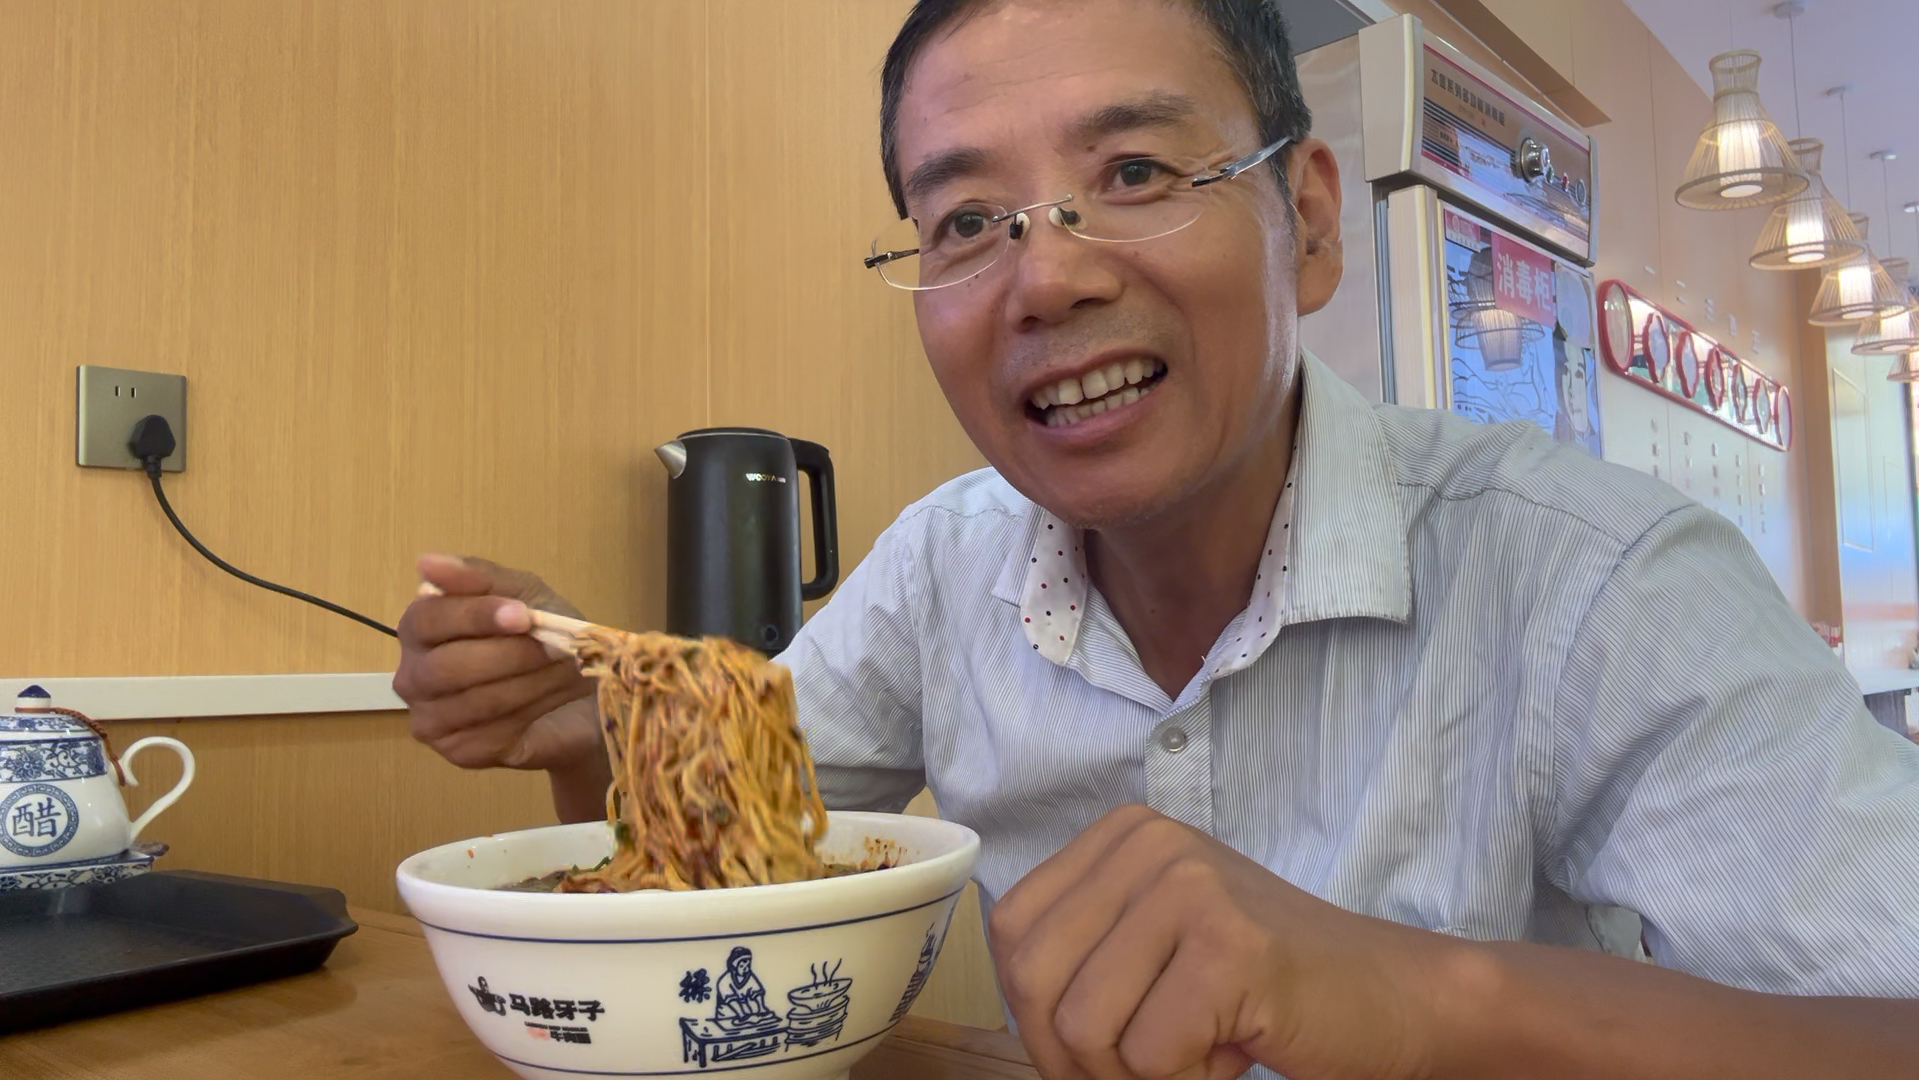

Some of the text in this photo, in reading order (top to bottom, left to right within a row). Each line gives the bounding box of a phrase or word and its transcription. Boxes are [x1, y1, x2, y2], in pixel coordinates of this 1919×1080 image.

[1496, 253, 1551, 312] 消毒柜
[12, 797, 61, 838] 醋
[509, 993, 605, 1021] 马路牙子
